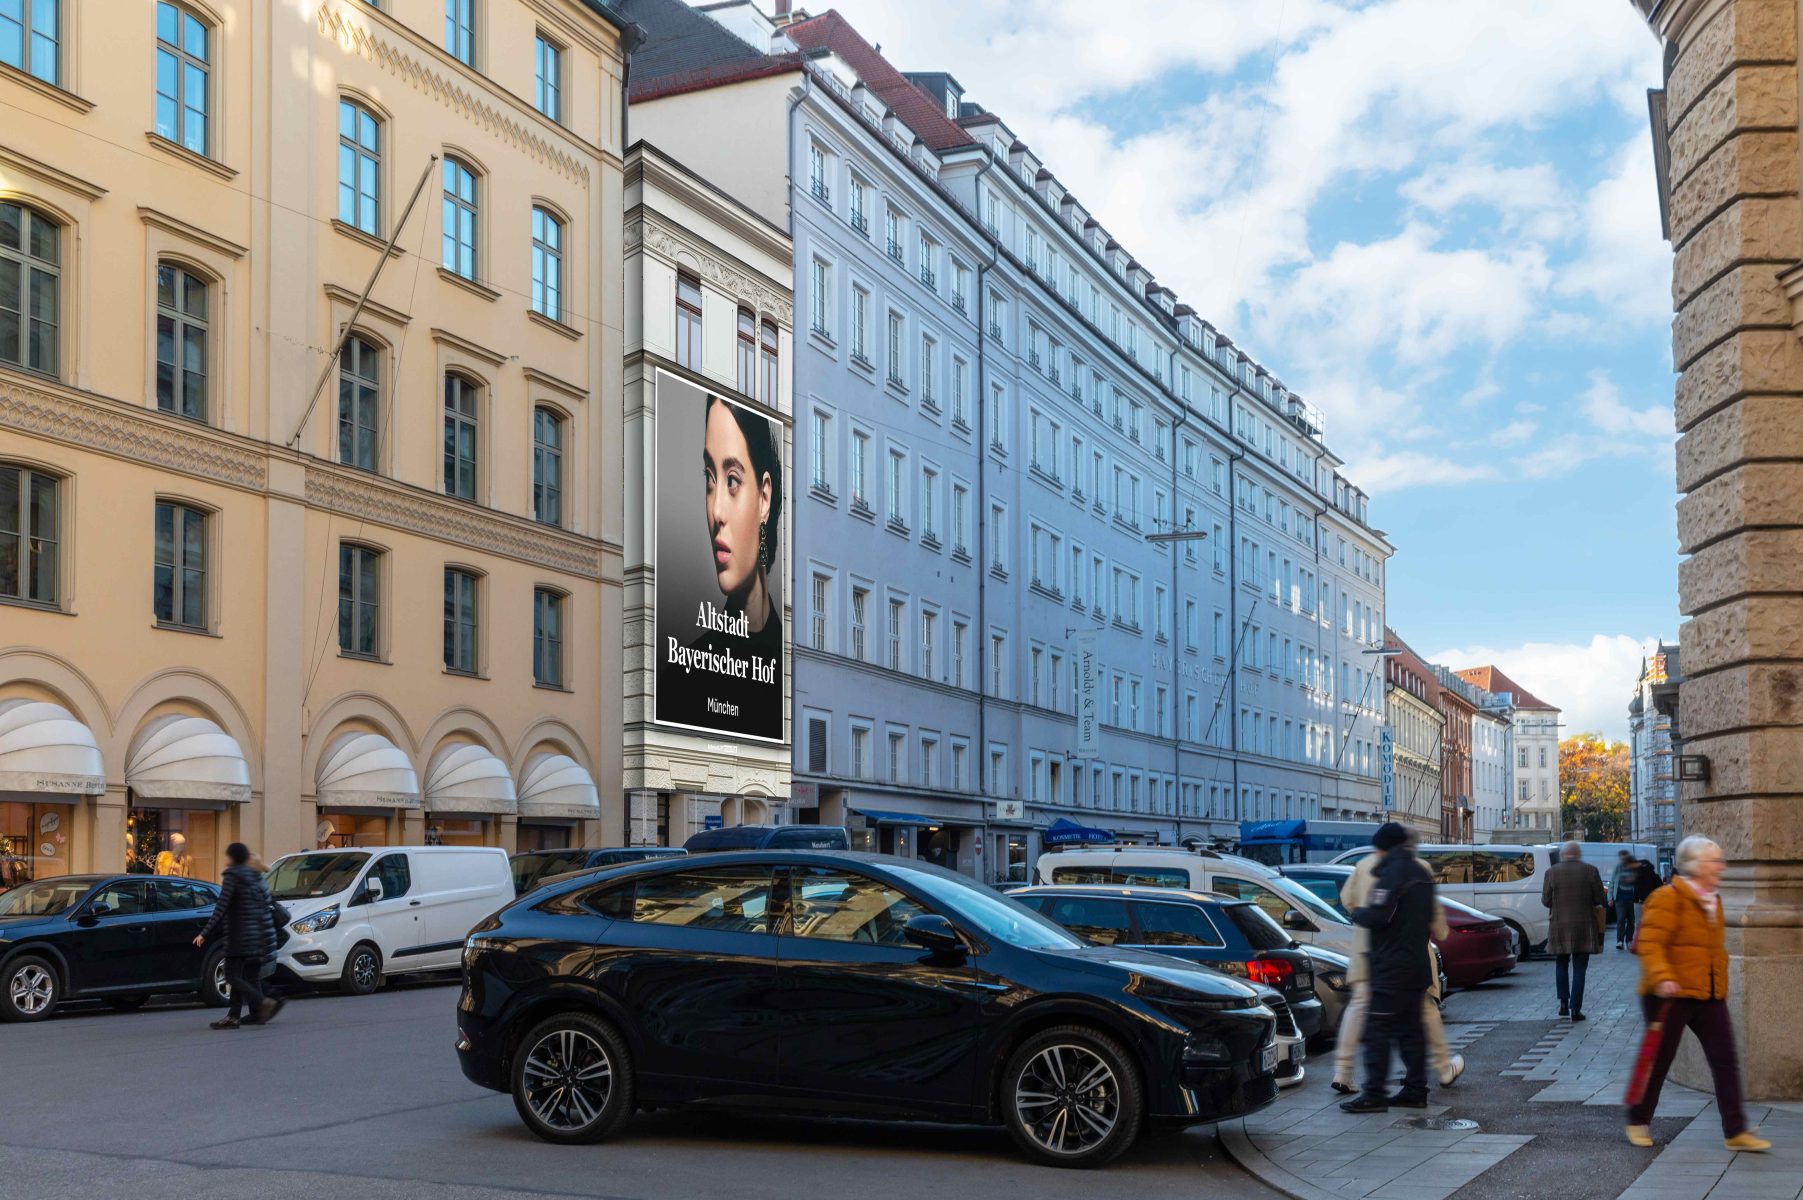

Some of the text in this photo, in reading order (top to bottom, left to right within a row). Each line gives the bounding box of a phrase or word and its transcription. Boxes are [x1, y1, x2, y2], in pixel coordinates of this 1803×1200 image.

[696, 601, 750, 638] Altstadt
[667, 635, 777, 685] Bayerischer Hof
[1082, 648, 1095, 694] Arnoldy
[707, 697, 739, 717] München
[1083, 698, 1094, 711] &
[1083, 711, 1094, 742] Team
[1382, 731, 1392, 806] KOMÖDIE
